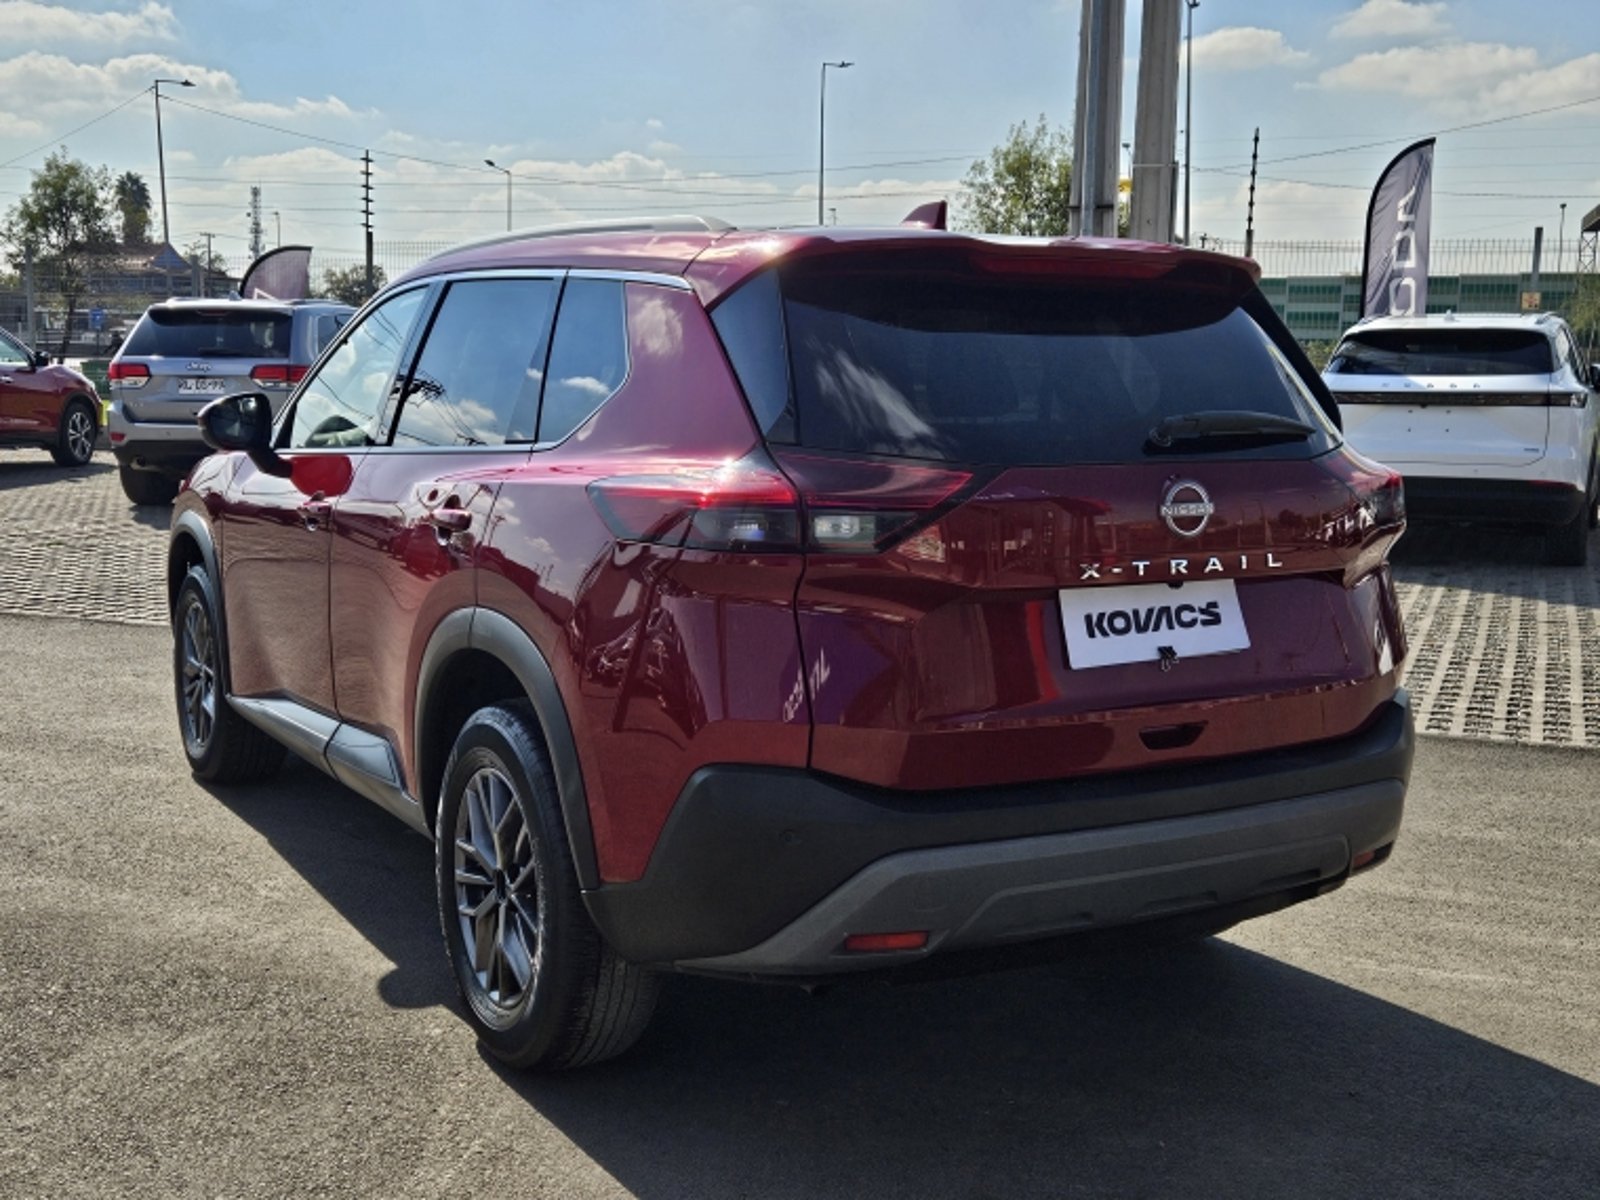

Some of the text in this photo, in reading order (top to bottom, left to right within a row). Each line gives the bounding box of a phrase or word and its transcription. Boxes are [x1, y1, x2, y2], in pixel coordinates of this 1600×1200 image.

[1161, 503, 1214, 517] NISSAN
[1079, 553, 1283, 580] X-TRAIL
[1084, 601, 1222, 638] KOVACS
